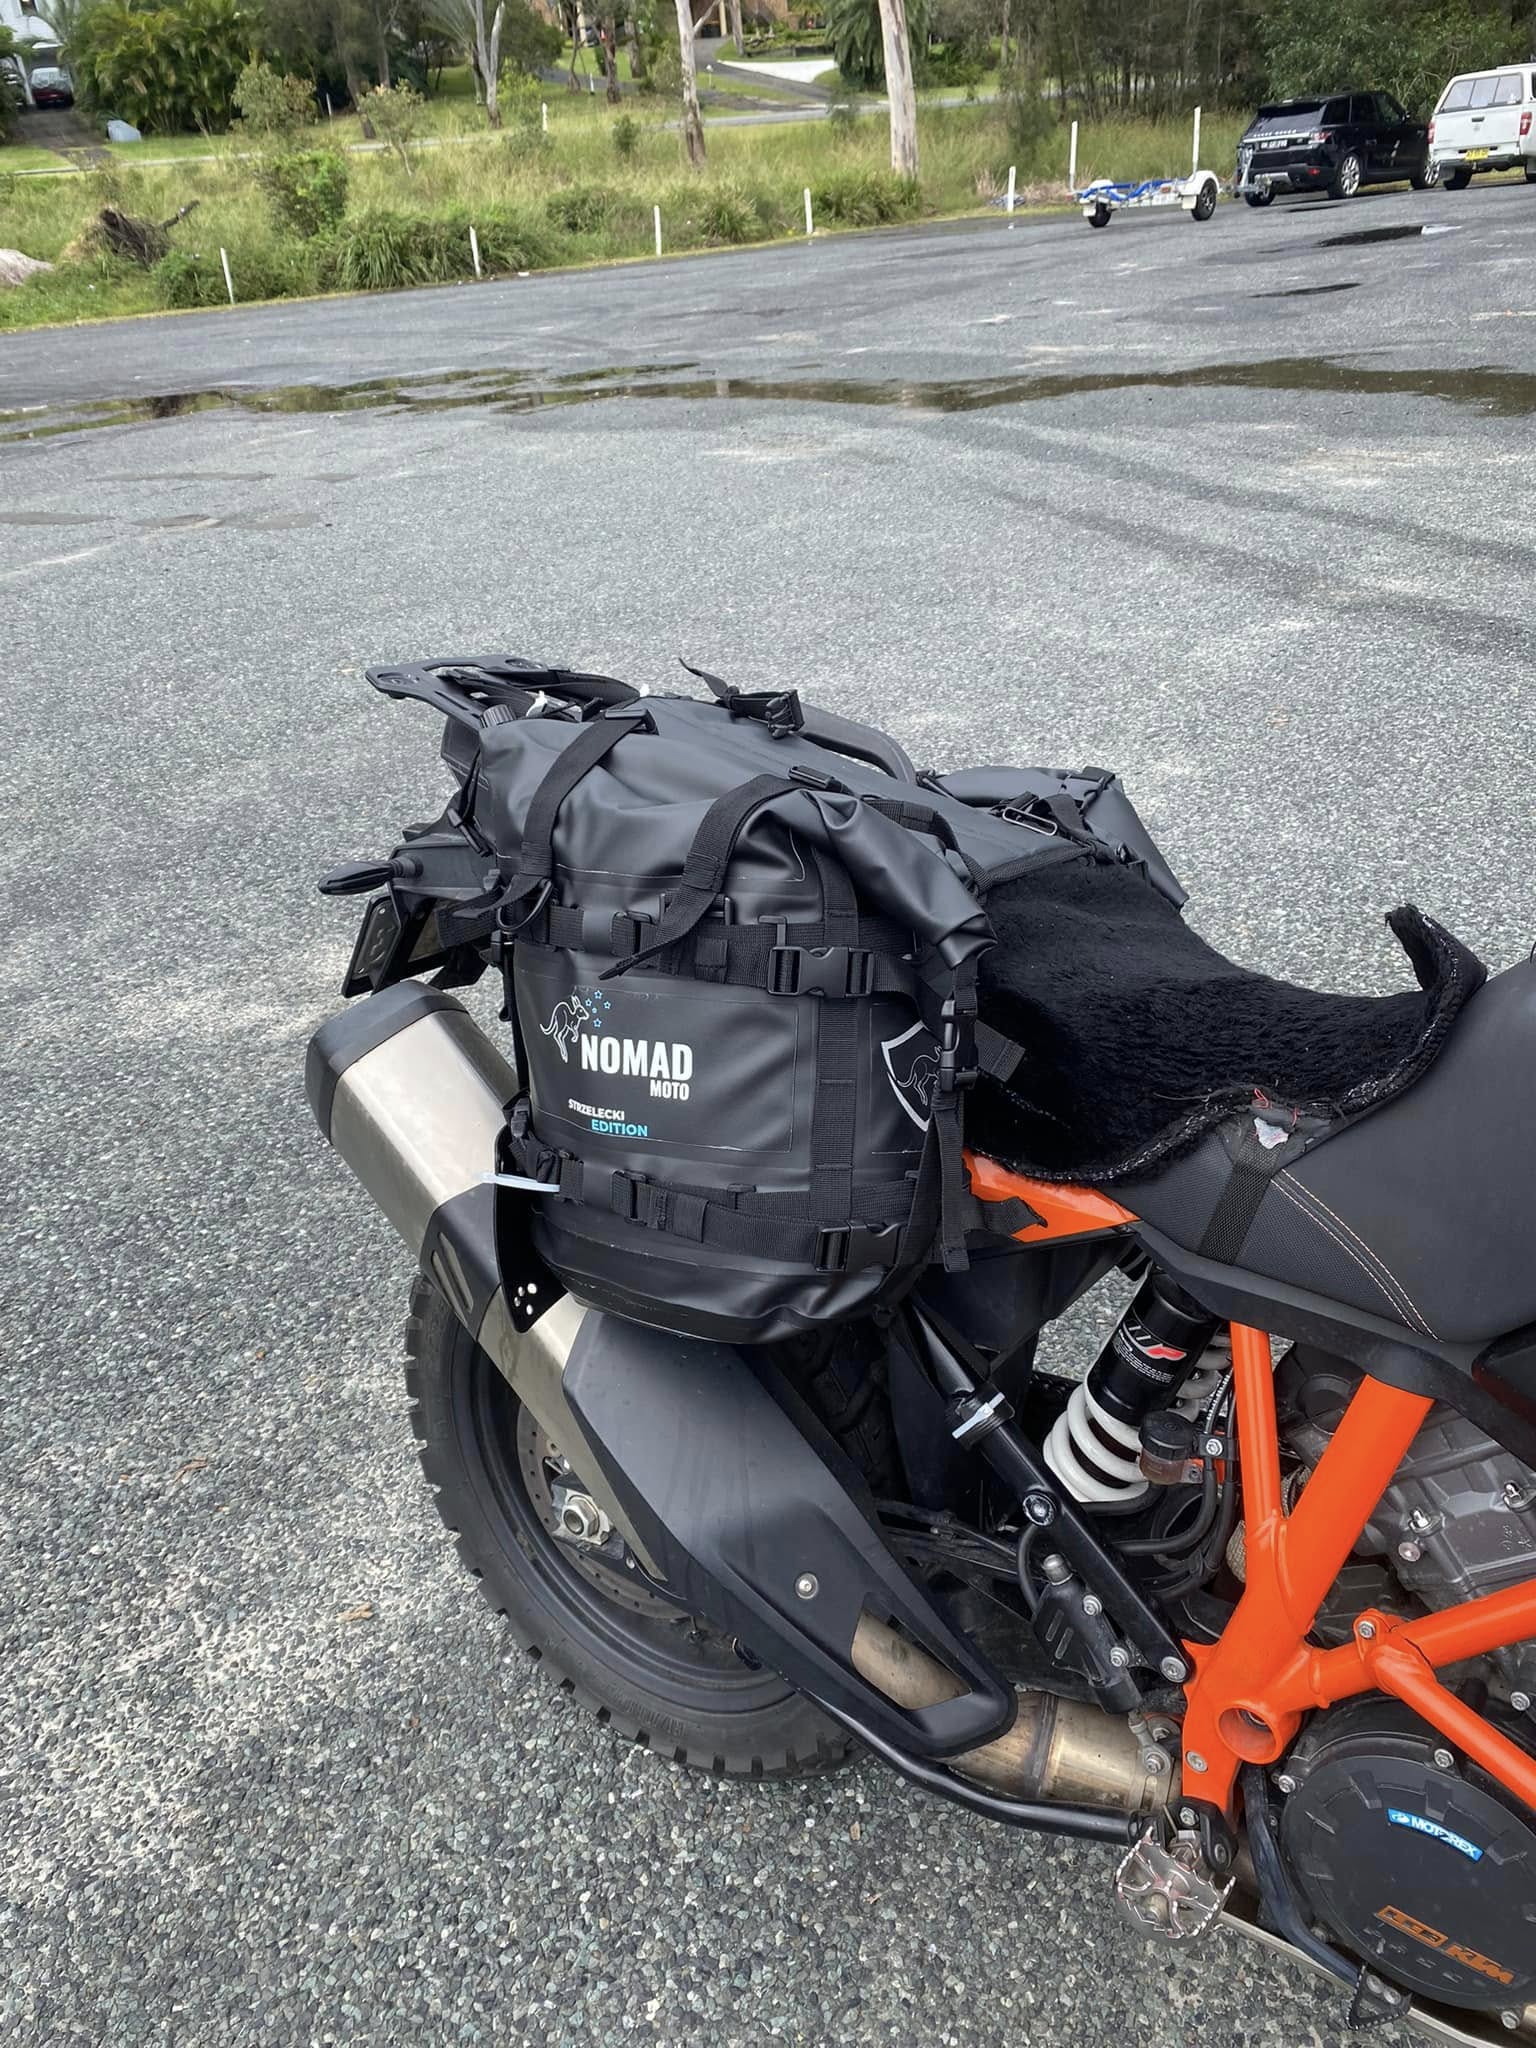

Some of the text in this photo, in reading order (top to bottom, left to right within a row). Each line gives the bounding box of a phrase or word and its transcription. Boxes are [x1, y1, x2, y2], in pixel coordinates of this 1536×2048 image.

[581, 1033, 693, 1081] NOMAD
[649, 1079, 690, 1101] MOTO
[568, 1098, 625, 1121] STRZELECKI
[591, 1119, 648, 1137] EDITION
[1411, 1816, 1475, 1858] MOTOREX
[1446, 1942, 1515, 1985] KTM
